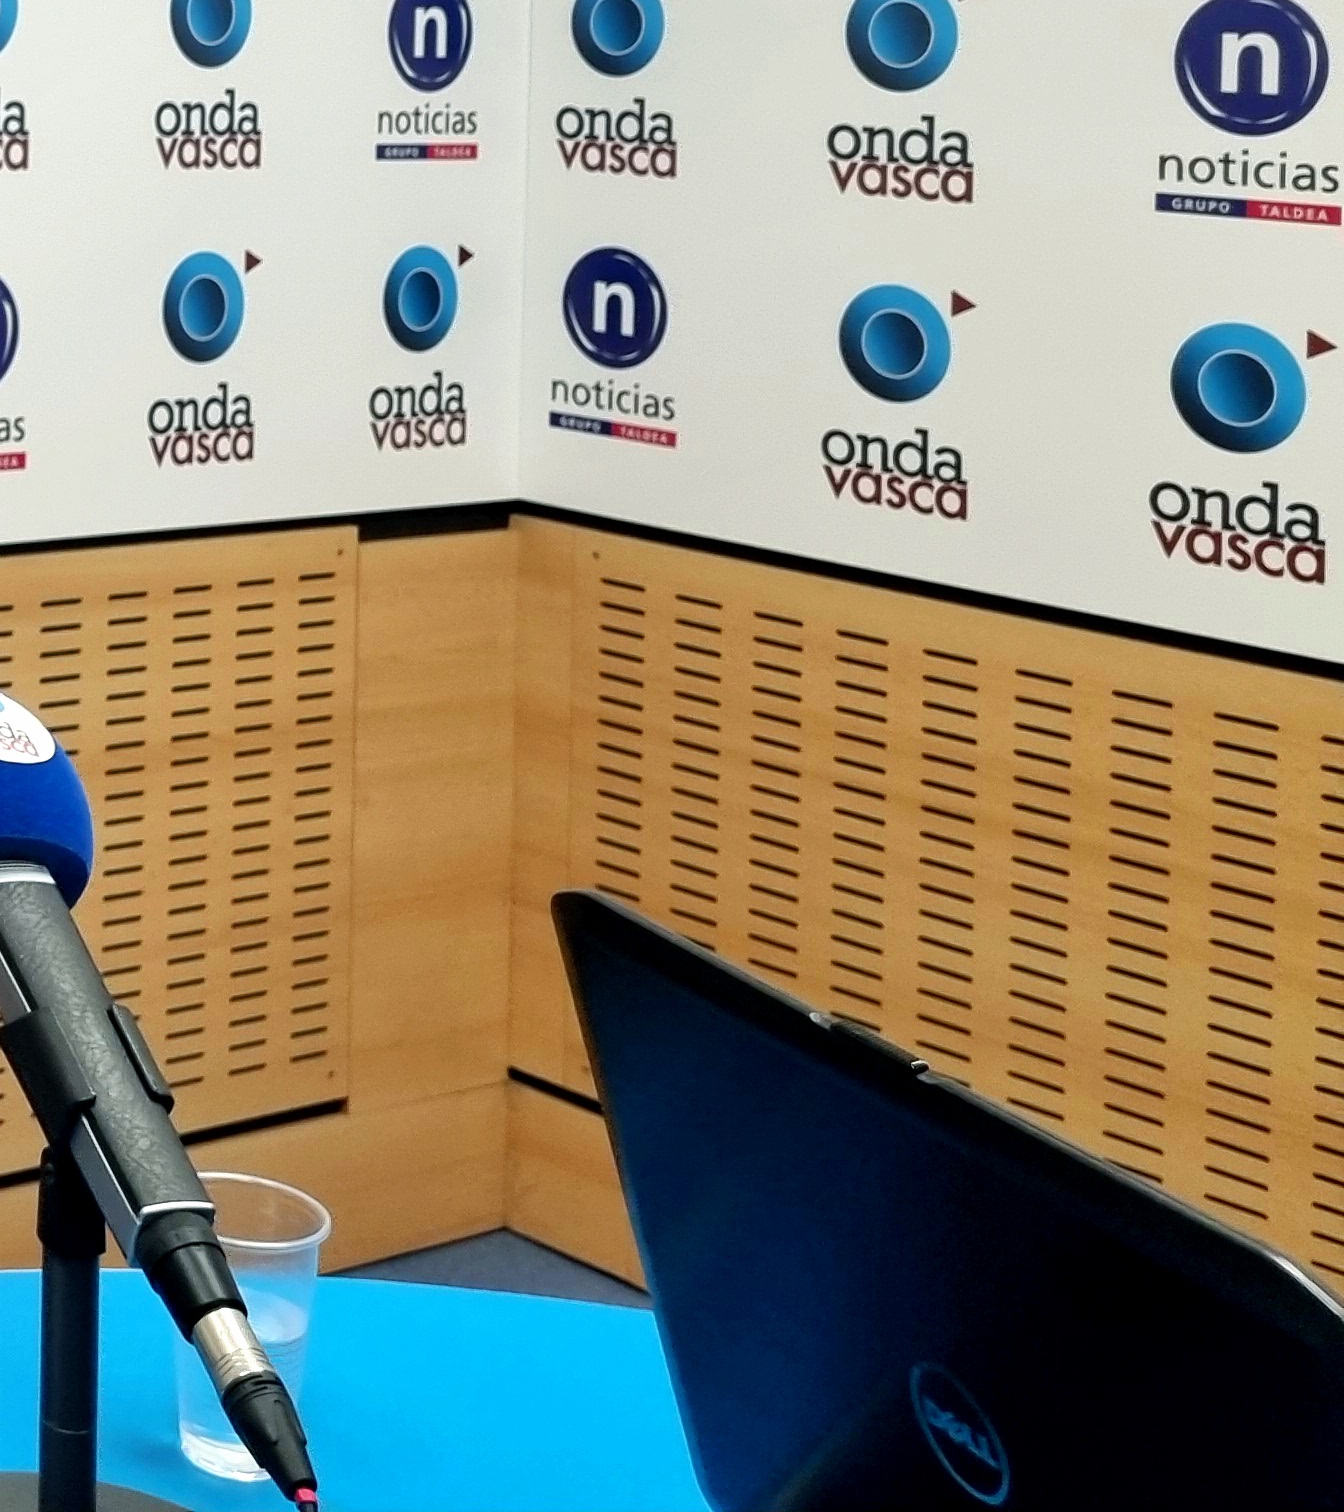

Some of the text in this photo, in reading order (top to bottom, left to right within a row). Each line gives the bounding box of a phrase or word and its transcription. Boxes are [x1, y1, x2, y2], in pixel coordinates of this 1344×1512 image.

[413, 4, 447, 59] n
[1219, 30, 1279, 96] n
[156, 90, 262, 137] onda
[377, 102, 478, 136] noticias
[556, 98, 676, 144] onda
[157, 135, 262, 170] vasca
[557, 141, 677, 179] vasca
[827, 115, 972, 168] onda
[828, 159, 974, 203] vasca
[1158, 148, 1339, 192] noticias
[1171, 198, 1328, 222] GRUPO TALDEA
[592, 279, 633, 337] n
[148, 384, 253, 435] onda
[369, 372, 465, 419] onda
[551, 379, 675, 420] noticias
[149, 428, 254, 467] vasca
[370, 414, 466, 452] vasca
[821, 427, 966, 485] onda
[823, 465, 968, 520] vasca
[1149, 482, 1324, 545] onda
[1153, 519, 1325, 584] vasca
